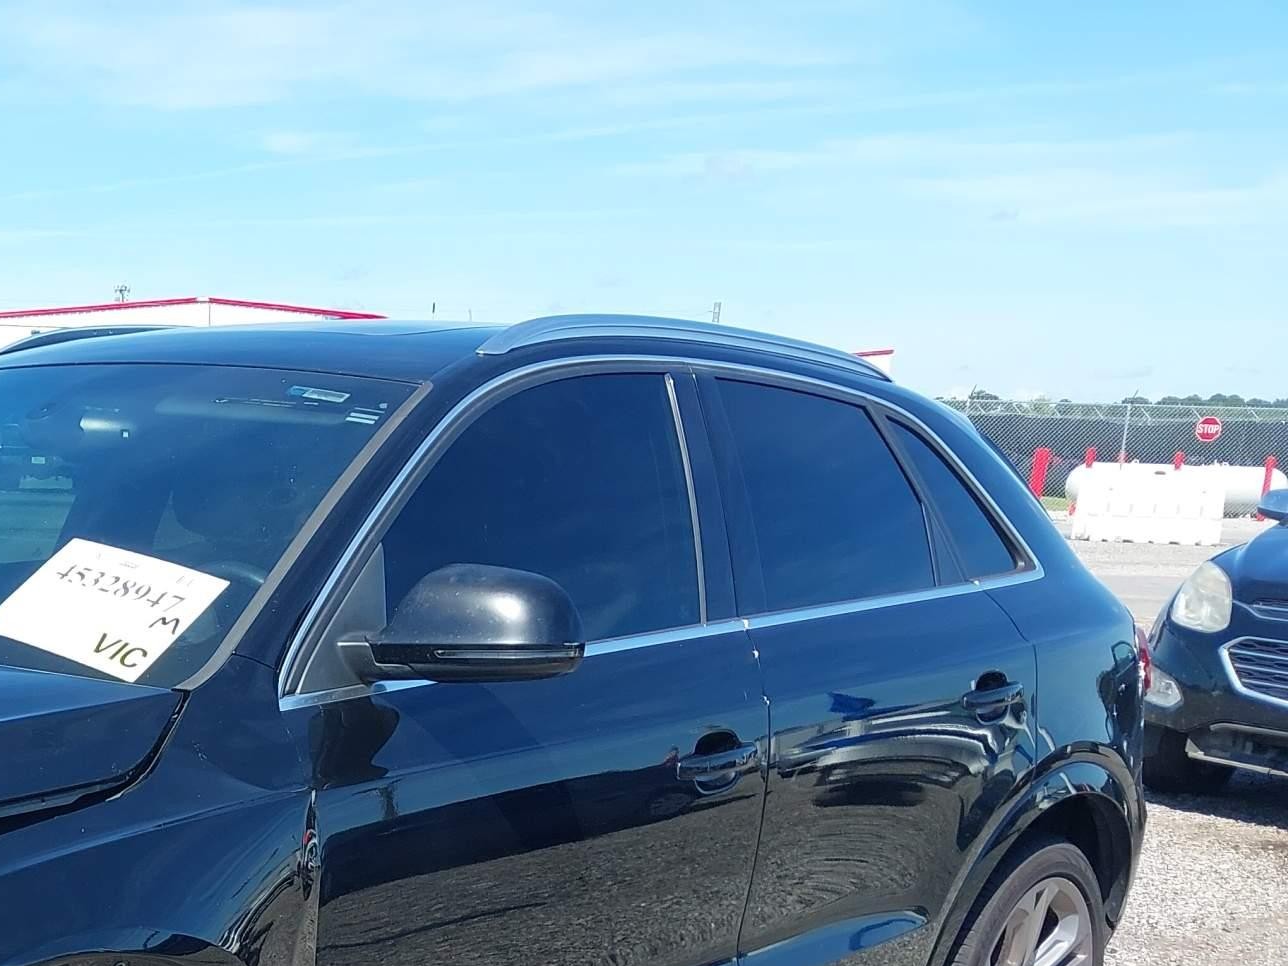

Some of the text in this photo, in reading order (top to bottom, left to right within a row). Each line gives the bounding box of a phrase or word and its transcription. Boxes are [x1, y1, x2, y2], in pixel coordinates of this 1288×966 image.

[1197, 424, 1220, 434] STOP
[57, 563, 186, 612] 45328947
[93, 632, 148, 668] VIC
